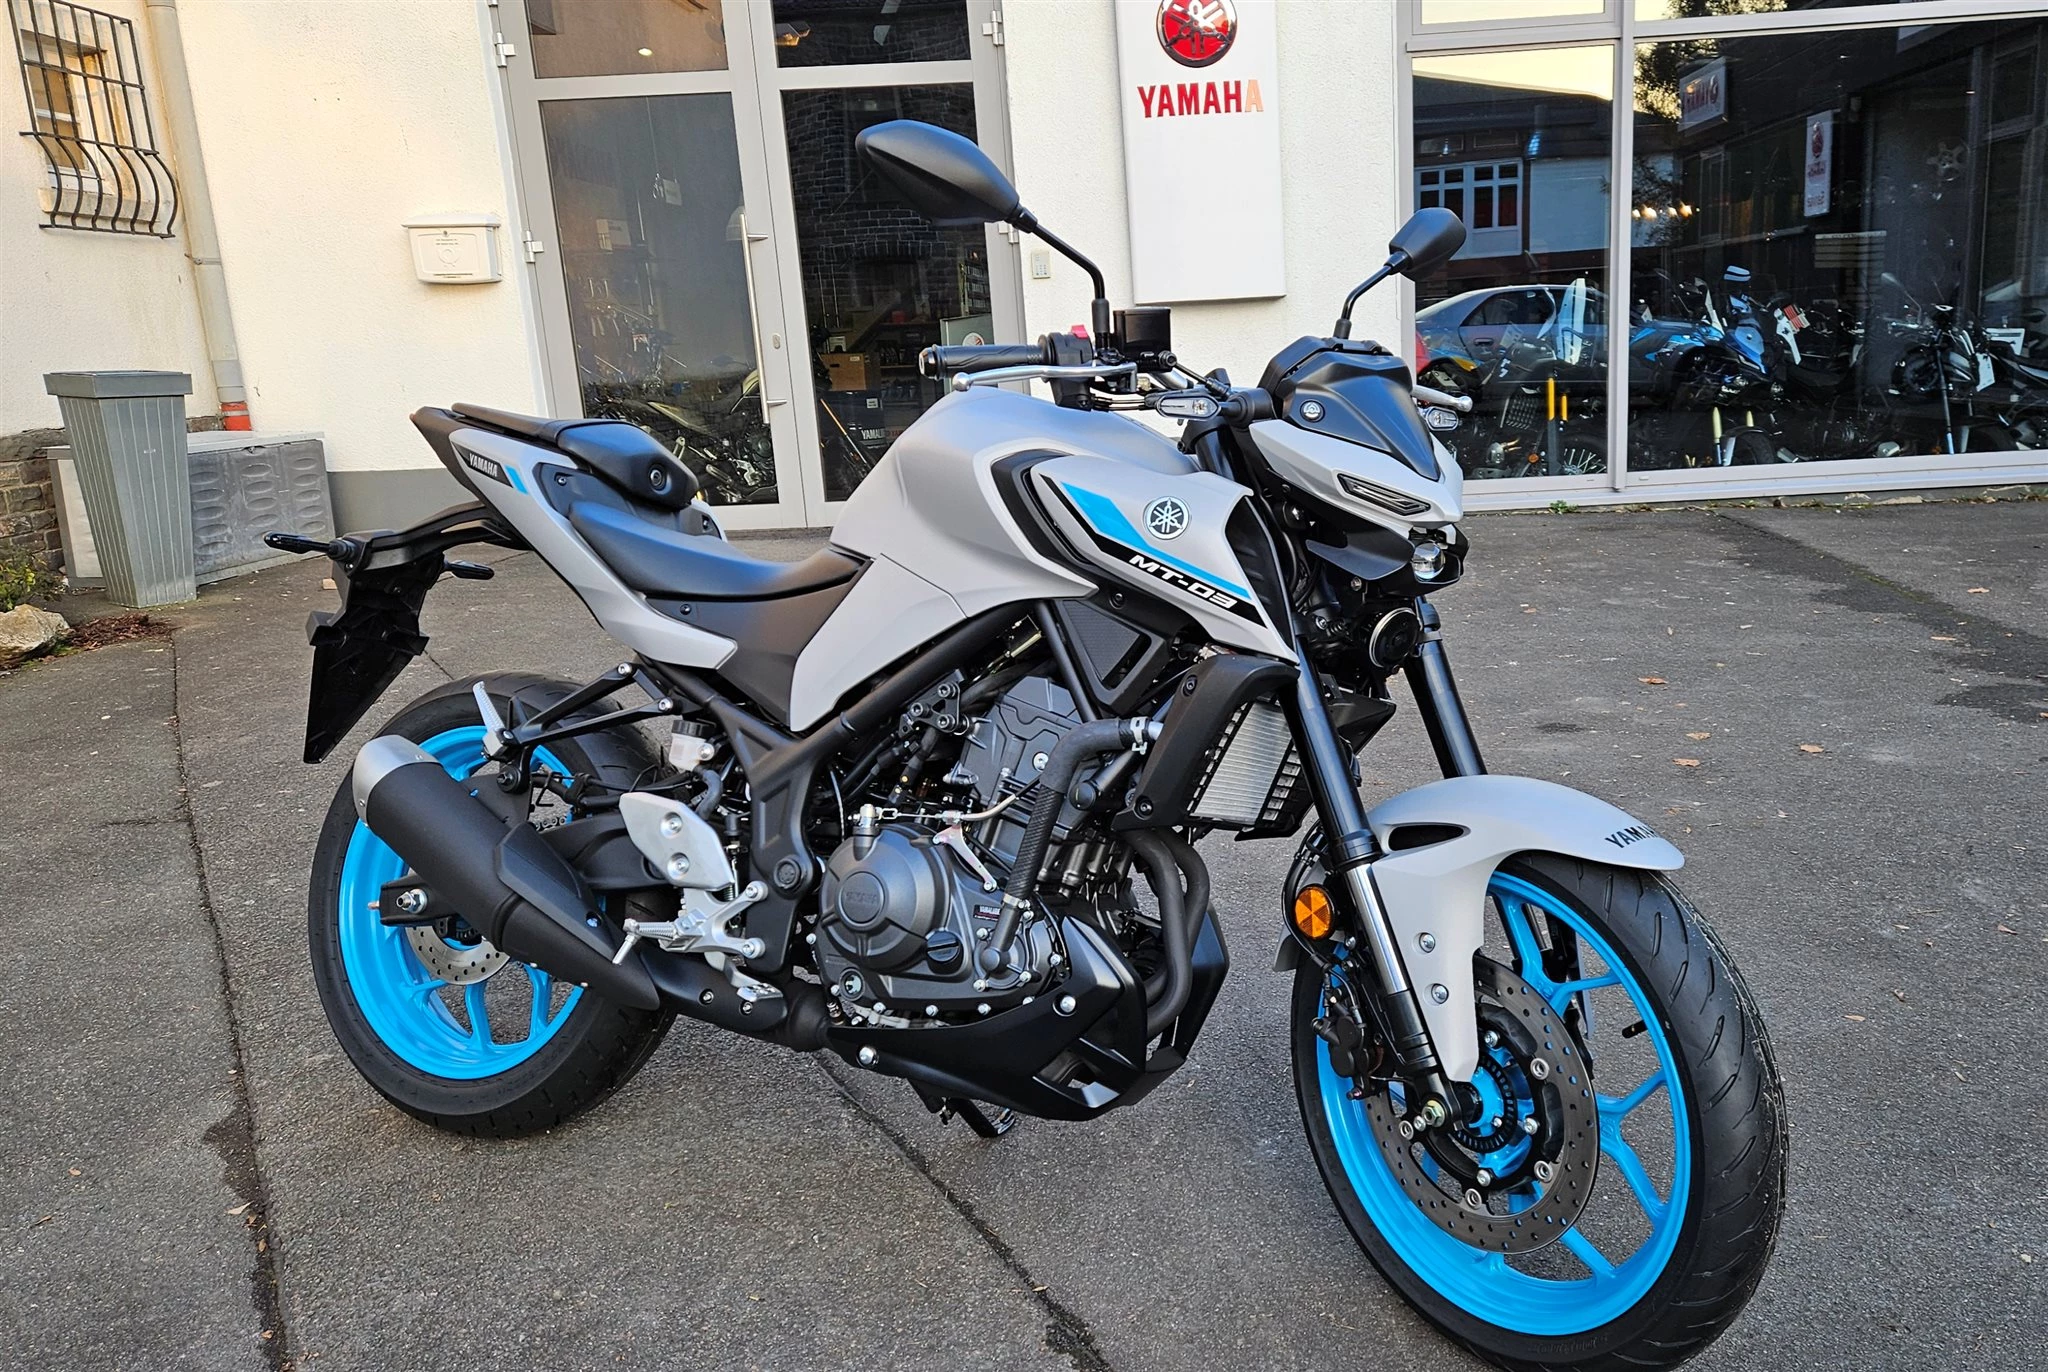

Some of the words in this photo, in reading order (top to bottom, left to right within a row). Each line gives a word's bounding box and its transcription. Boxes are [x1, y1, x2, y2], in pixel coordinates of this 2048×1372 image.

[1137, 79, 1264, 118] YAMAHA
[469, 452, 498, 478] YAMAHA
[1128, 554, 1238, 609] MT-03
